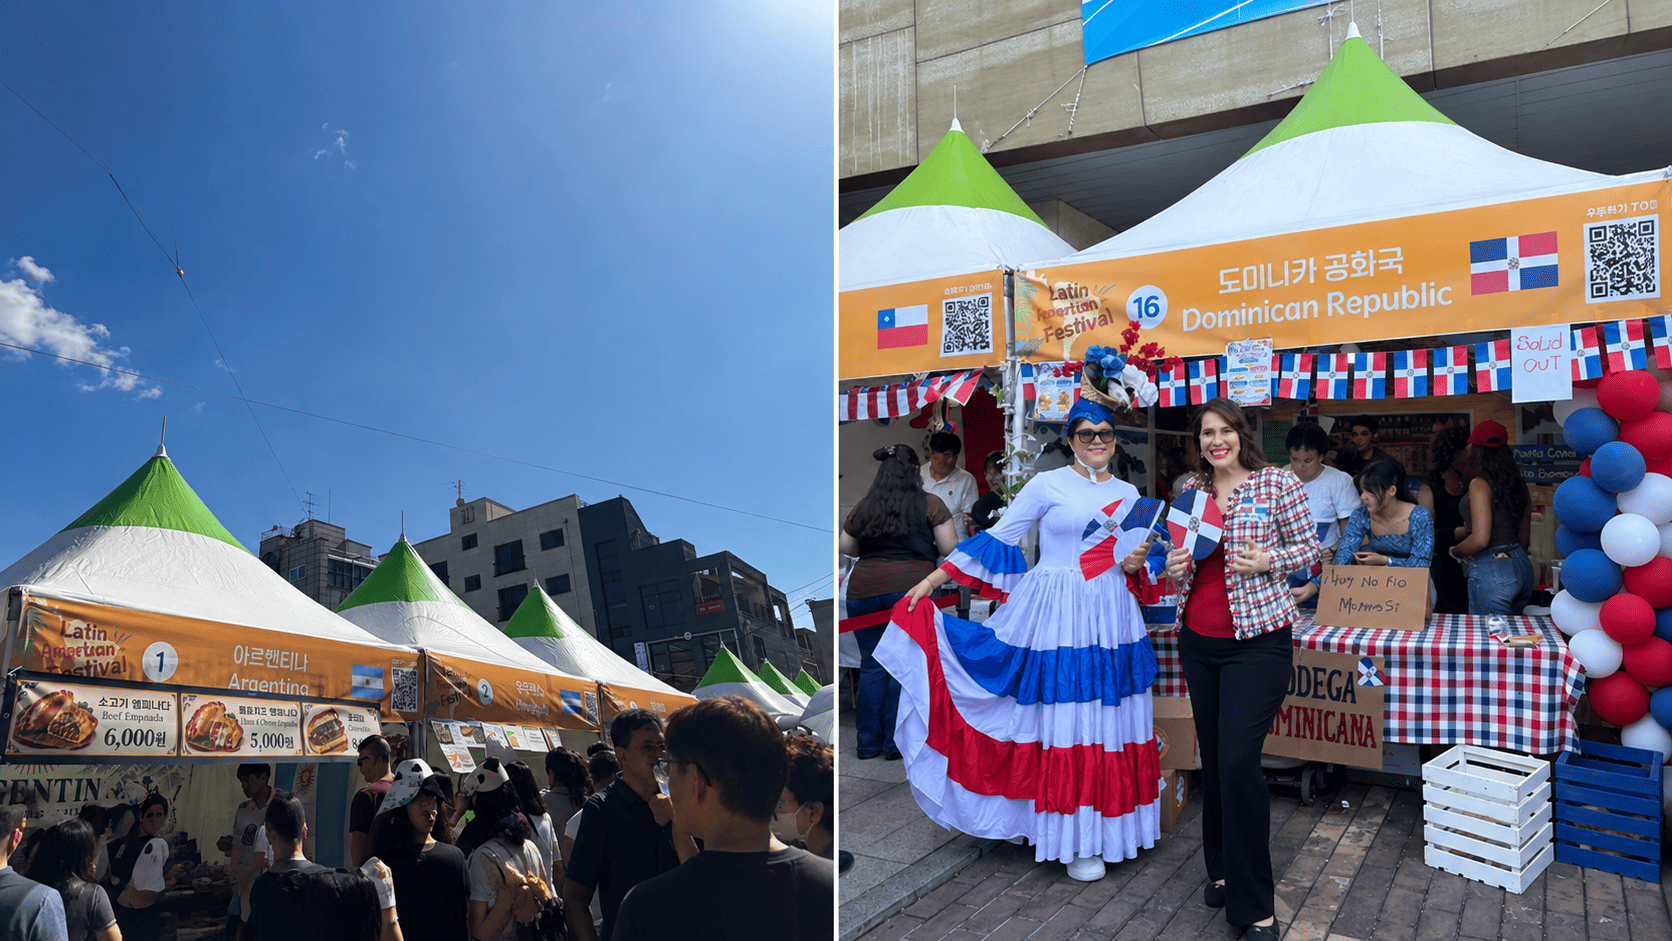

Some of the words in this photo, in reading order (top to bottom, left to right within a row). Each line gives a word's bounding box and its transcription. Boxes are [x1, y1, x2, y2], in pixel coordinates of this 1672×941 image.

[1219, 257, 1318, 294] 도미니카
[1324, 247, 1404, 282] 공화국
[1049, 283, 1088, 301] Latin
[1133, 295, 1160, 319] 16
[1183, 299, 1319, 332] Dominican
[1327, 281, 1453, 319] Republic
[1044, 307, 1114, 343] Festival
[1524, 355, 1561, 373] OUT
[60, 620, 107, 641] Latin
[156, 652, 165, 673] 1
[482, 684, 489, 698] 2
[98, 697, 128, 709] 소고기
[102, 711, 123, 720] Beef
[1269, 705, 1377, 749] MINICANA
[104, 728, 166, 751] 6,000원
